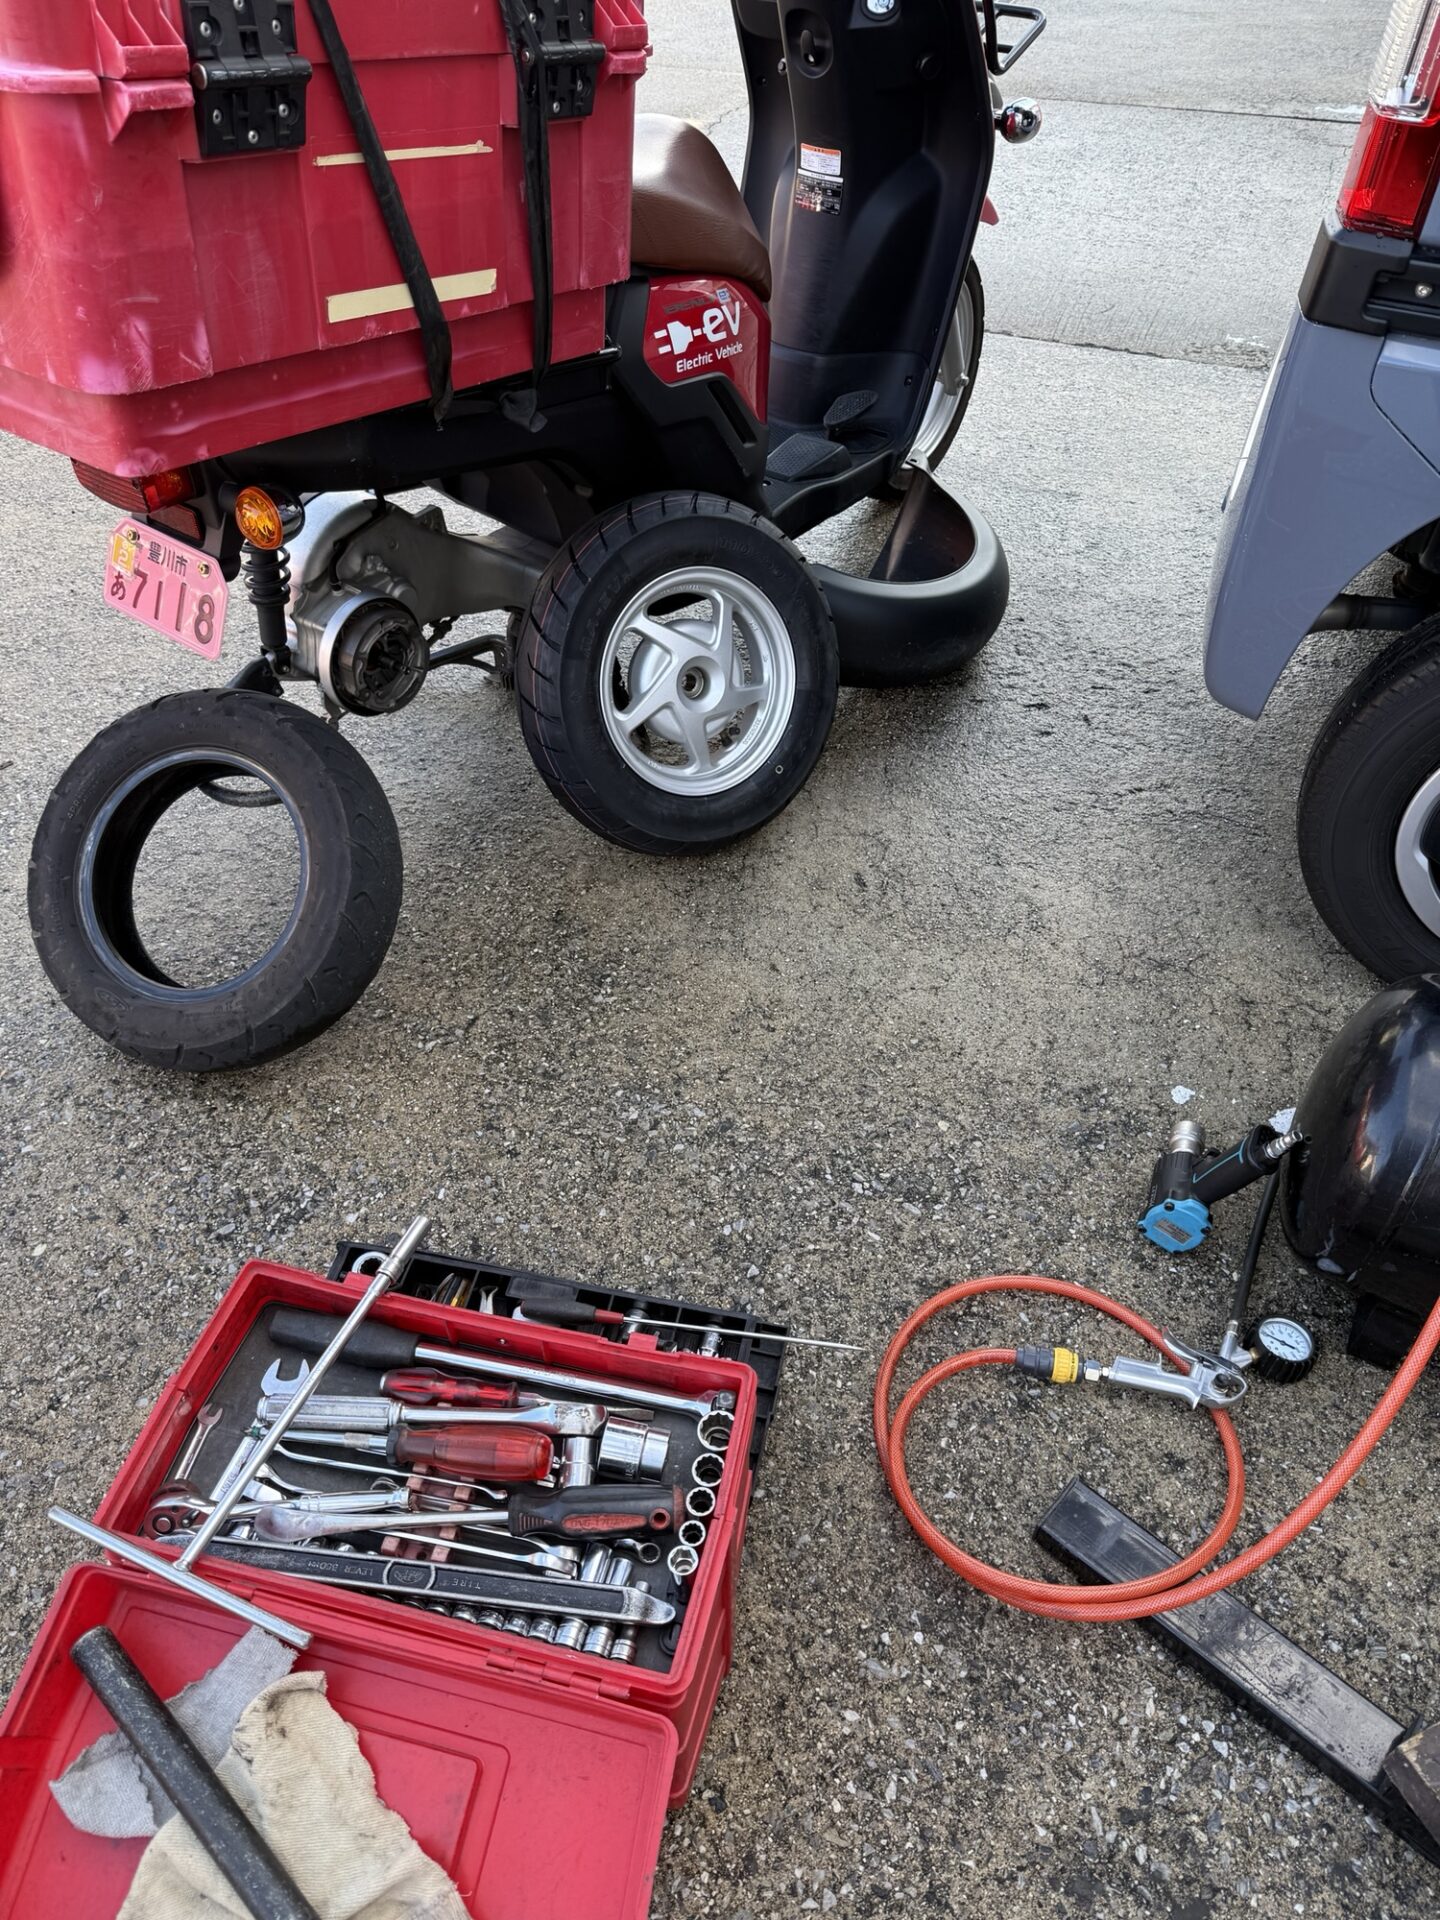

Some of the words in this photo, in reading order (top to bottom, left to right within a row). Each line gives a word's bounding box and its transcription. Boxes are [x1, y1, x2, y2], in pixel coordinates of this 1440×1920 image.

[676, 352, 713, 373] Electric
[715, 342, 743, 359] Vehicle
[148, 541, 188, 577] 豊川市
[110, 570, 127, 600] あ
[133, 567, 215, 644] 7118
[344, 1564, 375, 1577] LEVER
[451, 1577, 481, 1590] TIRE
